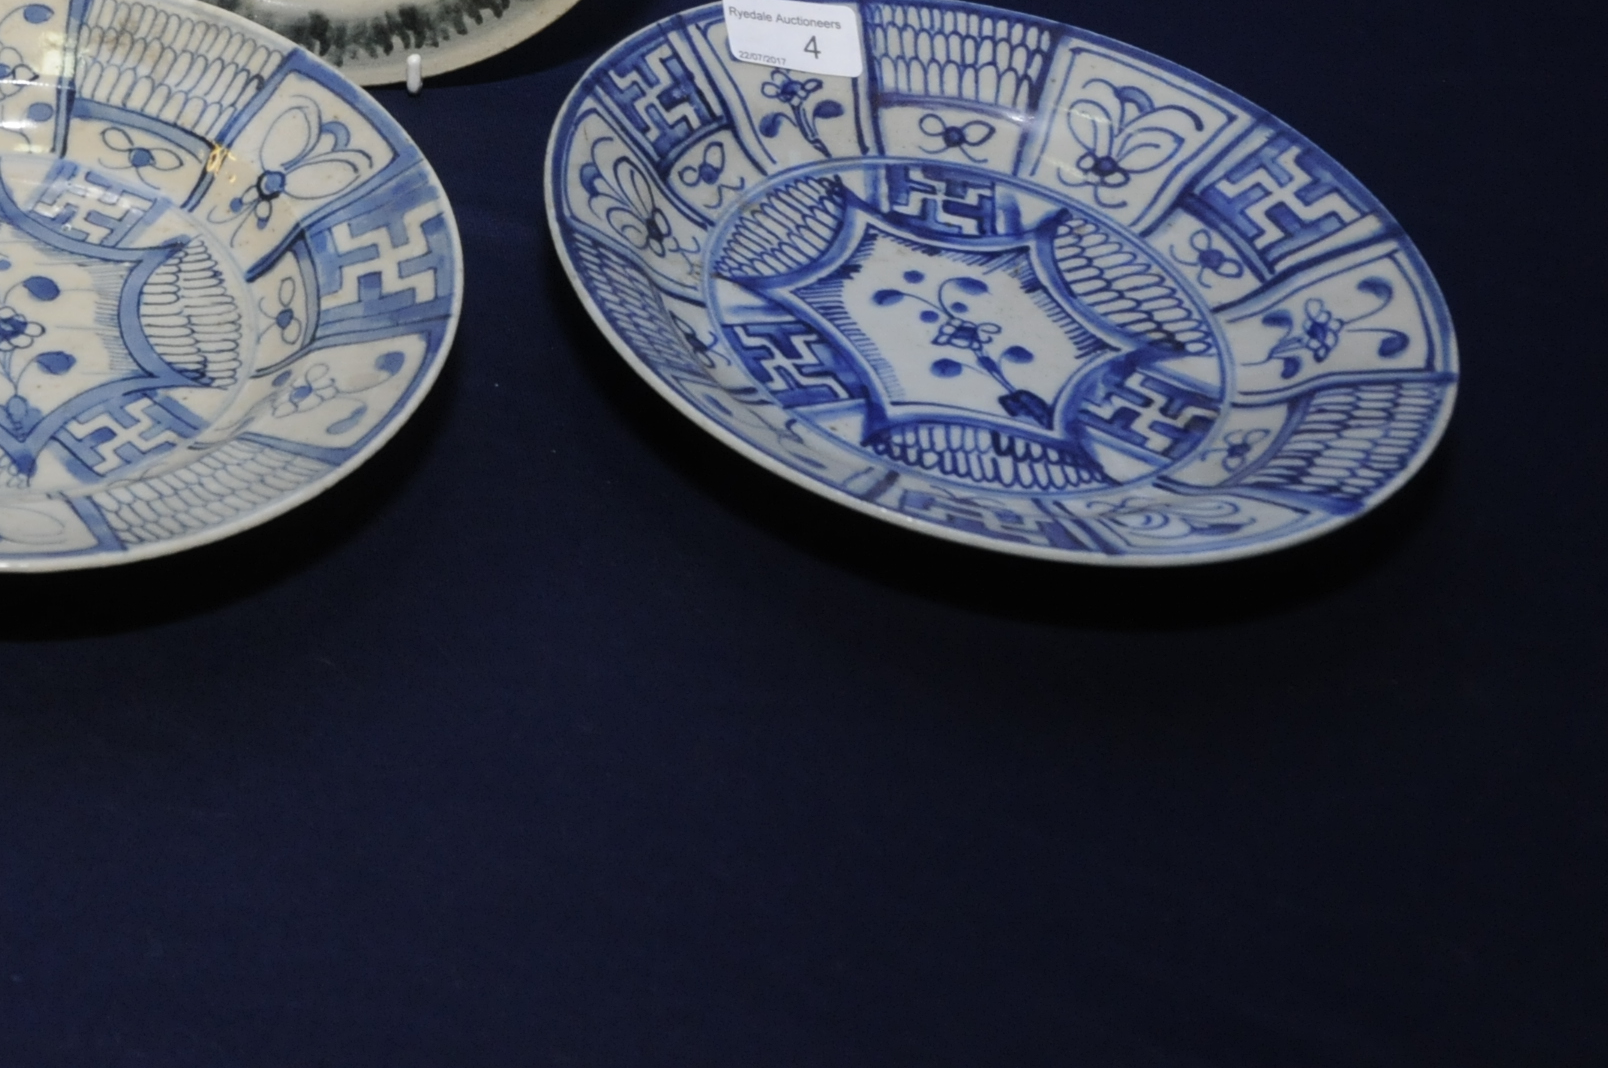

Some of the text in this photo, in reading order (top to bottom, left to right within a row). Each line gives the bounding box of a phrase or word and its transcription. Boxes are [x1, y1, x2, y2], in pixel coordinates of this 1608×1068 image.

[728, 6, 841, 30] Ryedale Auctioneers
[738, 50, 786, 66] 22/07/2017
[803, 35, 822, 60] 4
